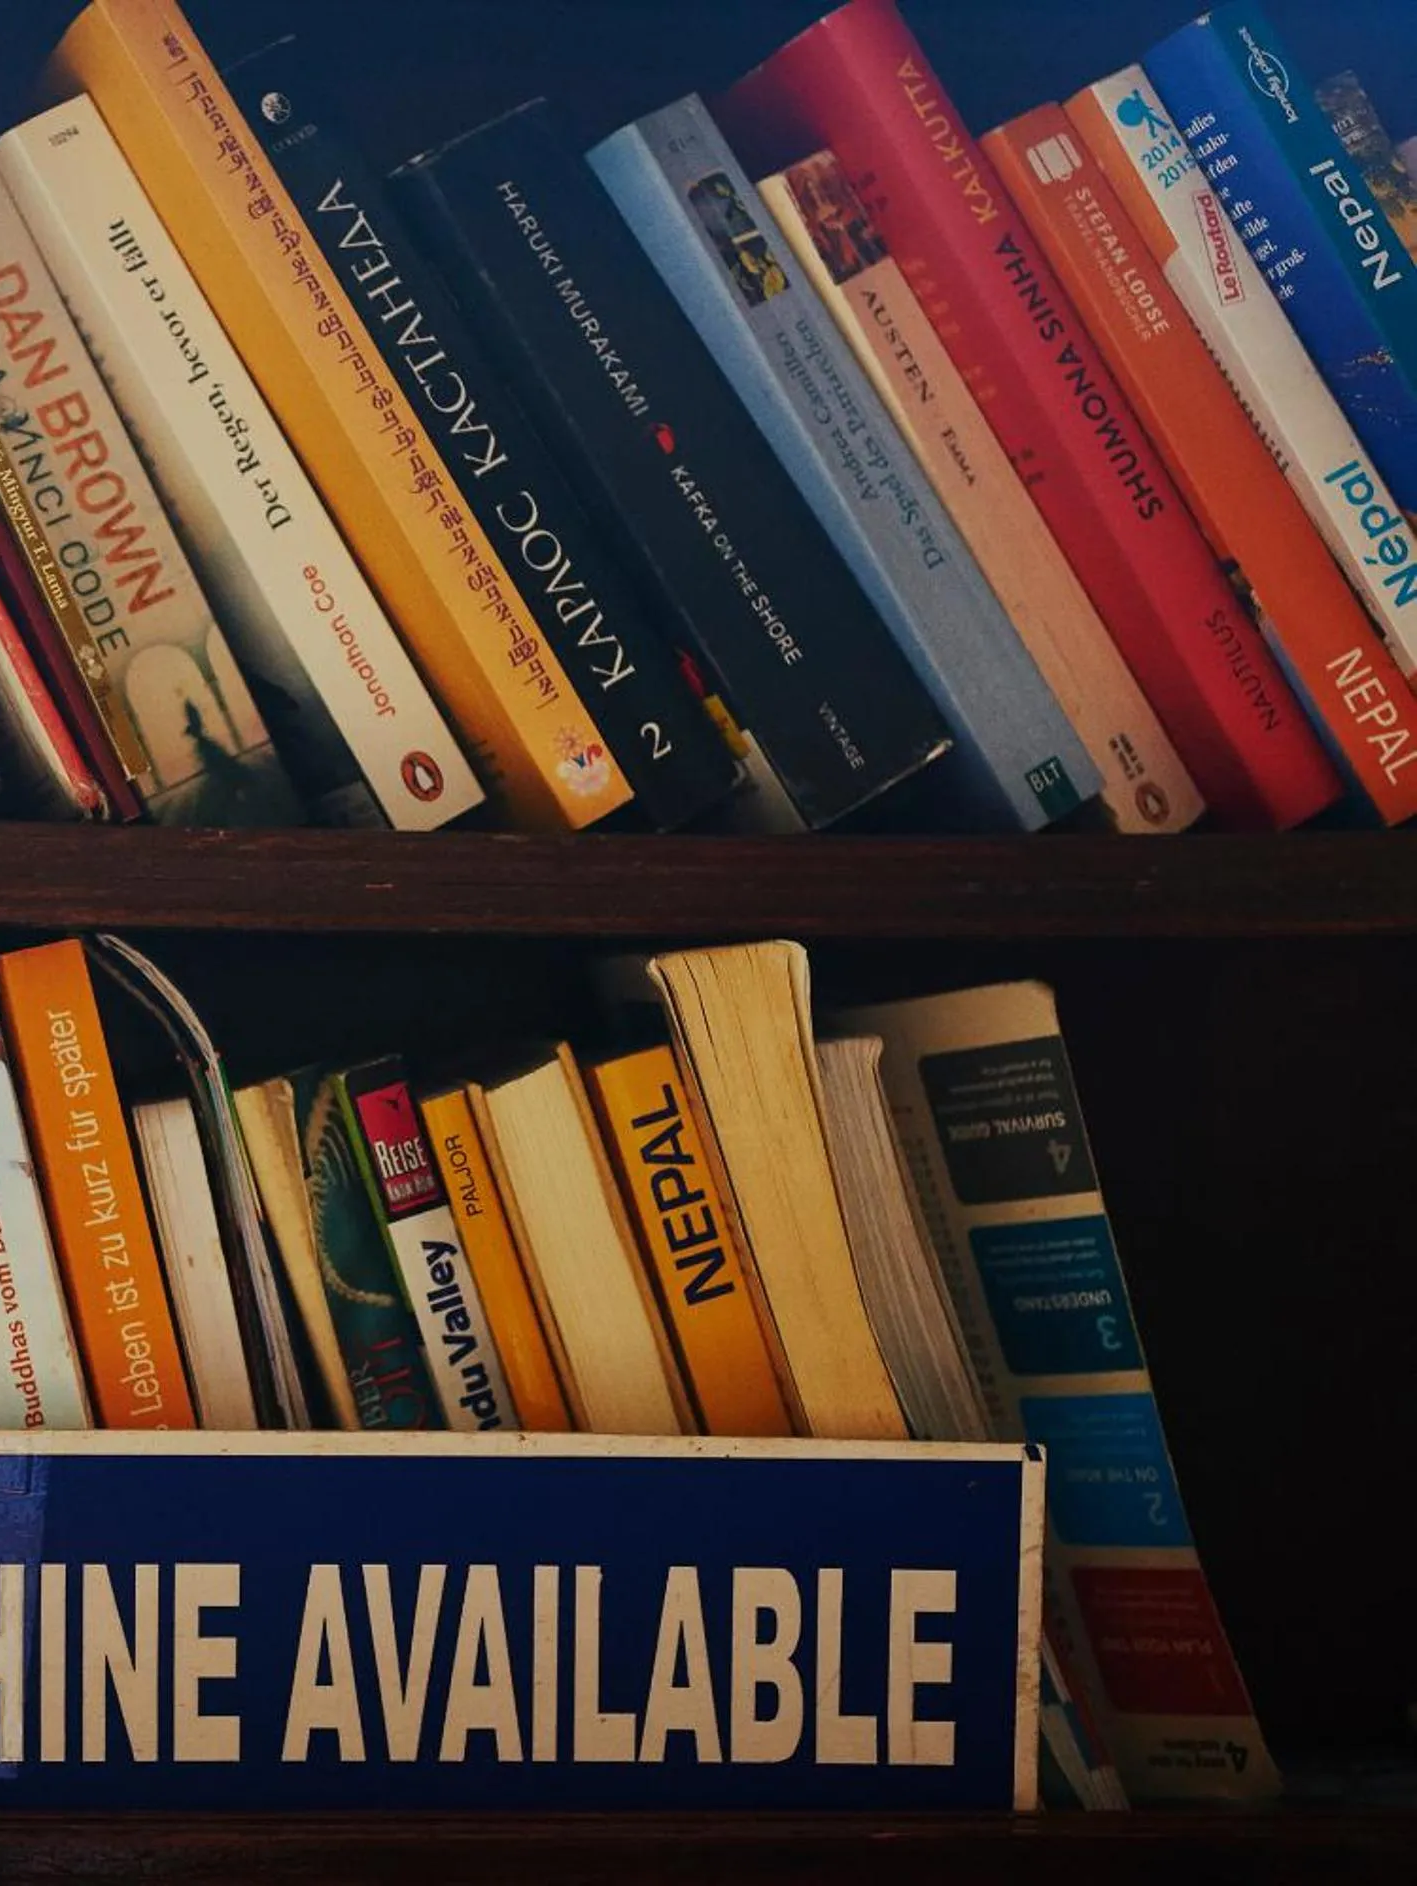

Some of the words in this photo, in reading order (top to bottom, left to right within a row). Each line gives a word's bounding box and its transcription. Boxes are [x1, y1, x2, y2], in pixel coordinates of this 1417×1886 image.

[1237, 25, 1273, 76] planet
[1266, 74, 1299, 125] lonely
[895, 55, 1000, 227] KALKUTTA
[1140, 134, 1183, 171] 2014
[1214, 153, 1240, 175] den
[108, 215, 149, 275] fällt
[1074, 185, 1130, 275] STEFAN
[1120, 266, 1172, 338] LOOSE
[1196, 193, 1233, 275] Routard
[1308, 158, 1404, 292] Nepal
[140, 274, 168, 304] er
[495, 178, 562, 280] HARUKI
[554, 274, 652, 419] MURAKAMI
[993, 230, 1069, 343] SINHA
[1223, 275, 1242, 302] Le
[159, 307, 211, 387] bevor
[316, 176, 510, 481] КАСТАНЕДА
[858, 287, 935, 405] AUSTEN
[795, 317, 867, 434] Patriarchen
[206, 380, 265, 479] Regen,
[829, 425, 883, 504] Andrea
[860, 430, 892, 472] des
[1054, 339, 1166, 523] SHUMONA
[0, 467, 39, 539] Mingyur
[34, 389, 177, 616] BROWN
[253, 470, 295, 533] Der
[879, 466, 925, 527] Spiel
[1323, 459, 1417, 610] Népal
[31, 539, 50, 560] T.
[40, 559, 70, 610] Lama
[669, 463, 720, 539] KAFKA
[712, 531, 737, 565] ON
[728, 555, 761, 602] THE
[750, 591, 805, 667] SHORE
[911, 523, 946, 572] Das
[58, 539, 132, 659] CODE
[300, 562, 337, 615] Coe
[495, 489, 637, 692] КАРЛОС
[329, 611, 398, 720] Jonathan
[1204, 607, 1281, 732] NAUTILUS
[639, 719, 674, 762] 2
[816, 701, 867, 773] VINTAGE
[1324, 645, 1417, 787] NEPAL
[44, 1007, 96, 1101] später
[64, 1109, 101, 1155] für
[374, 1136, 428, 1179] REISE
[995, 1109, 1067, 1137] SURVIVAL
[1046, 1139, 1073, 1176] 4
[75, 1158, 123, 1230] kurz
[443, 1133, 484, 1218] PALJOR
[630, 1082, 738, 1308] NEPAL
[99, 1231, 127, 1273] zu
[106, 1279, 140, 1317] ist
[420, 1238, 478, 1369] Valley
[1095, 1314, 1123, 1352] 3
[1, 1318, 47, 1430] Buddhas
[119, 1320, 164, 1419] Leben
[1142, 1491, 1169, 1526] 2
[280, 1562, 960, 1768] AVAILABLE
